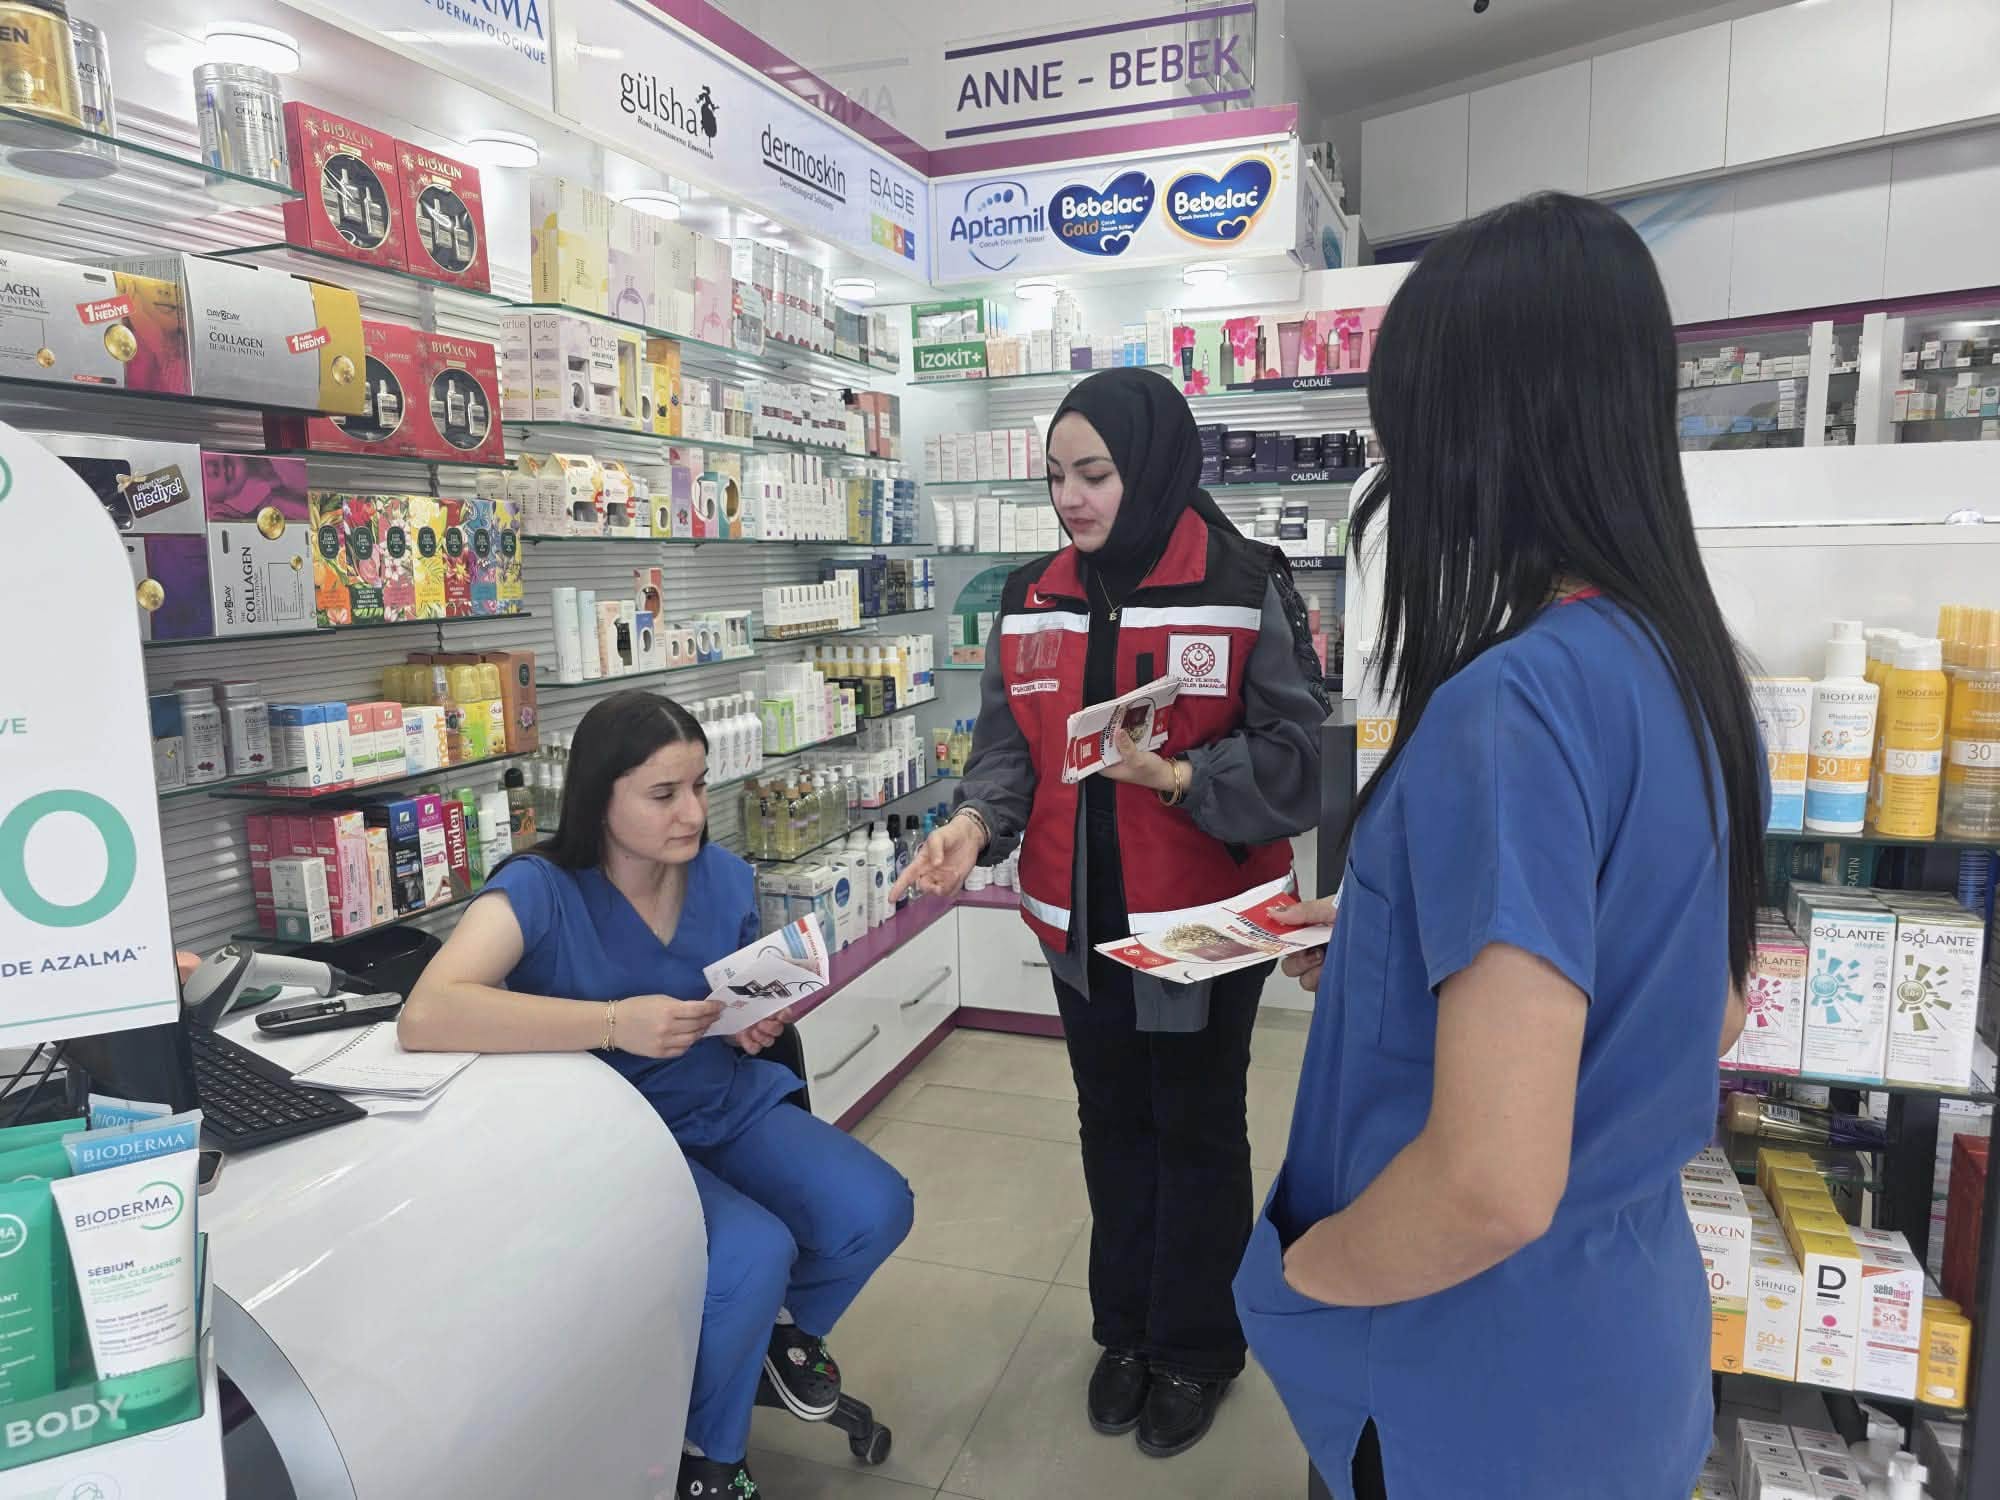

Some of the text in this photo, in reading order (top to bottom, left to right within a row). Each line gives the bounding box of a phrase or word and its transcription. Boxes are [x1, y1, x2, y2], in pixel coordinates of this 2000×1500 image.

[437, 0, 547, 65] DERMATOLOGIQUE
[956, 59, 1064, 112] ANNE
[1108, 34, 1241, 92] BEBEK
[620, 72, 698, 137] gülsha
[417, 153, 463, 180] BIOXCIN
[761, 123, 847, 195] dermoskin
[1061, 194, 1145, 220] Bebelac
[1174, 188, 1258, 215] Bebelac
[950, 205, 1045, 245] Aptamil
[1062, 219, 1099, 238] Gold
[208, 331, 264, 349] COLLAGEN
[431, 340, 478, 360] BIOXCIN
[132, 476, 182, 512] Hediye!
[241, 546, 257, 624] COLLAGEN
[1363, 720, 1392, 744] 50
[1967, 743, 1992, 761] 30
[1816, 758, 1838, 775] 50
[447, 807, 466, 870] lapiden
[1813, 926, 1886, 942] SOLANTE
[1901, 931, 1977, 948] SOLANTE
[2, 961, 33, 978] DE
[82, 1132, 186, 1163] BIODERMA
[74, 1194, 173, 1228] BIODERMA
[1816, 1264, 1847, 1291] D
[5, 1393, 126, 1448] BODY
